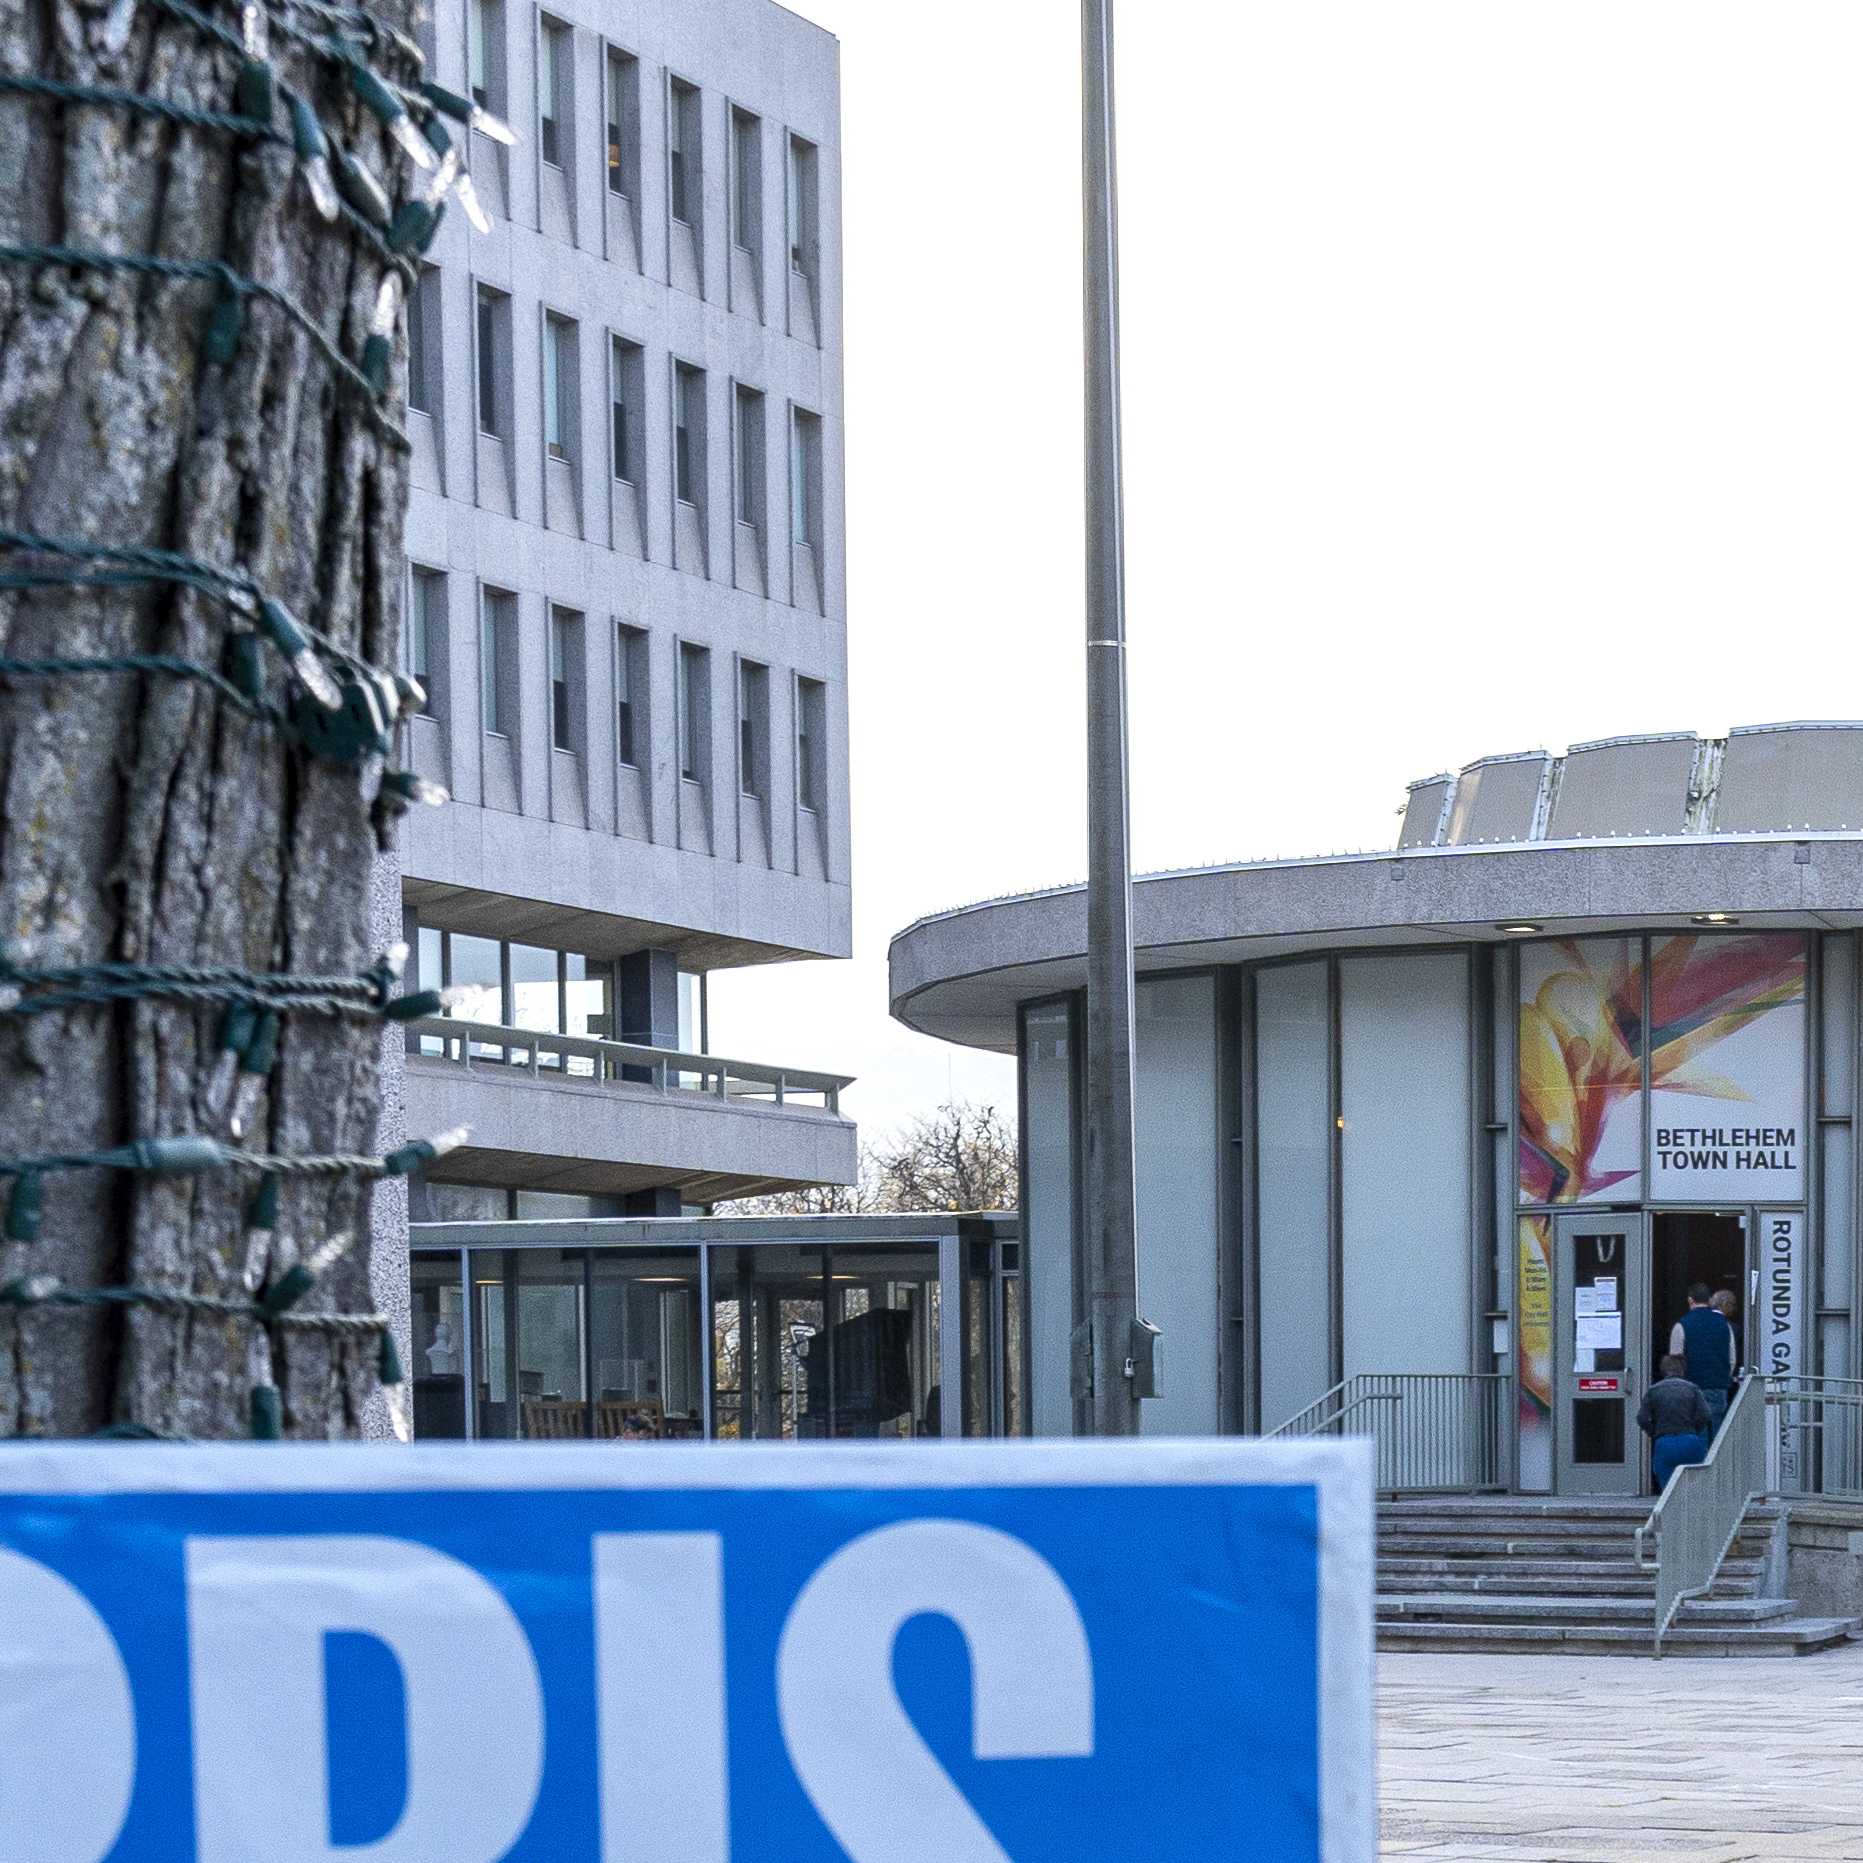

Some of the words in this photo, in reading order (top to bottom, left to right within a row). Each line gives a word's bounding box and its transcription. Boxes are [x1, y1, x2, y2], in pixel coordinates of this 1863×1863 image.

[1656, 1128, 1796, 1147] BETHLEHEM
[1656, 1150, 1728, 1170] TOWN
[1735, 1150, 1797, 1170] HALL
[1771, 1219, 1792, 1336] ROTUNDA
